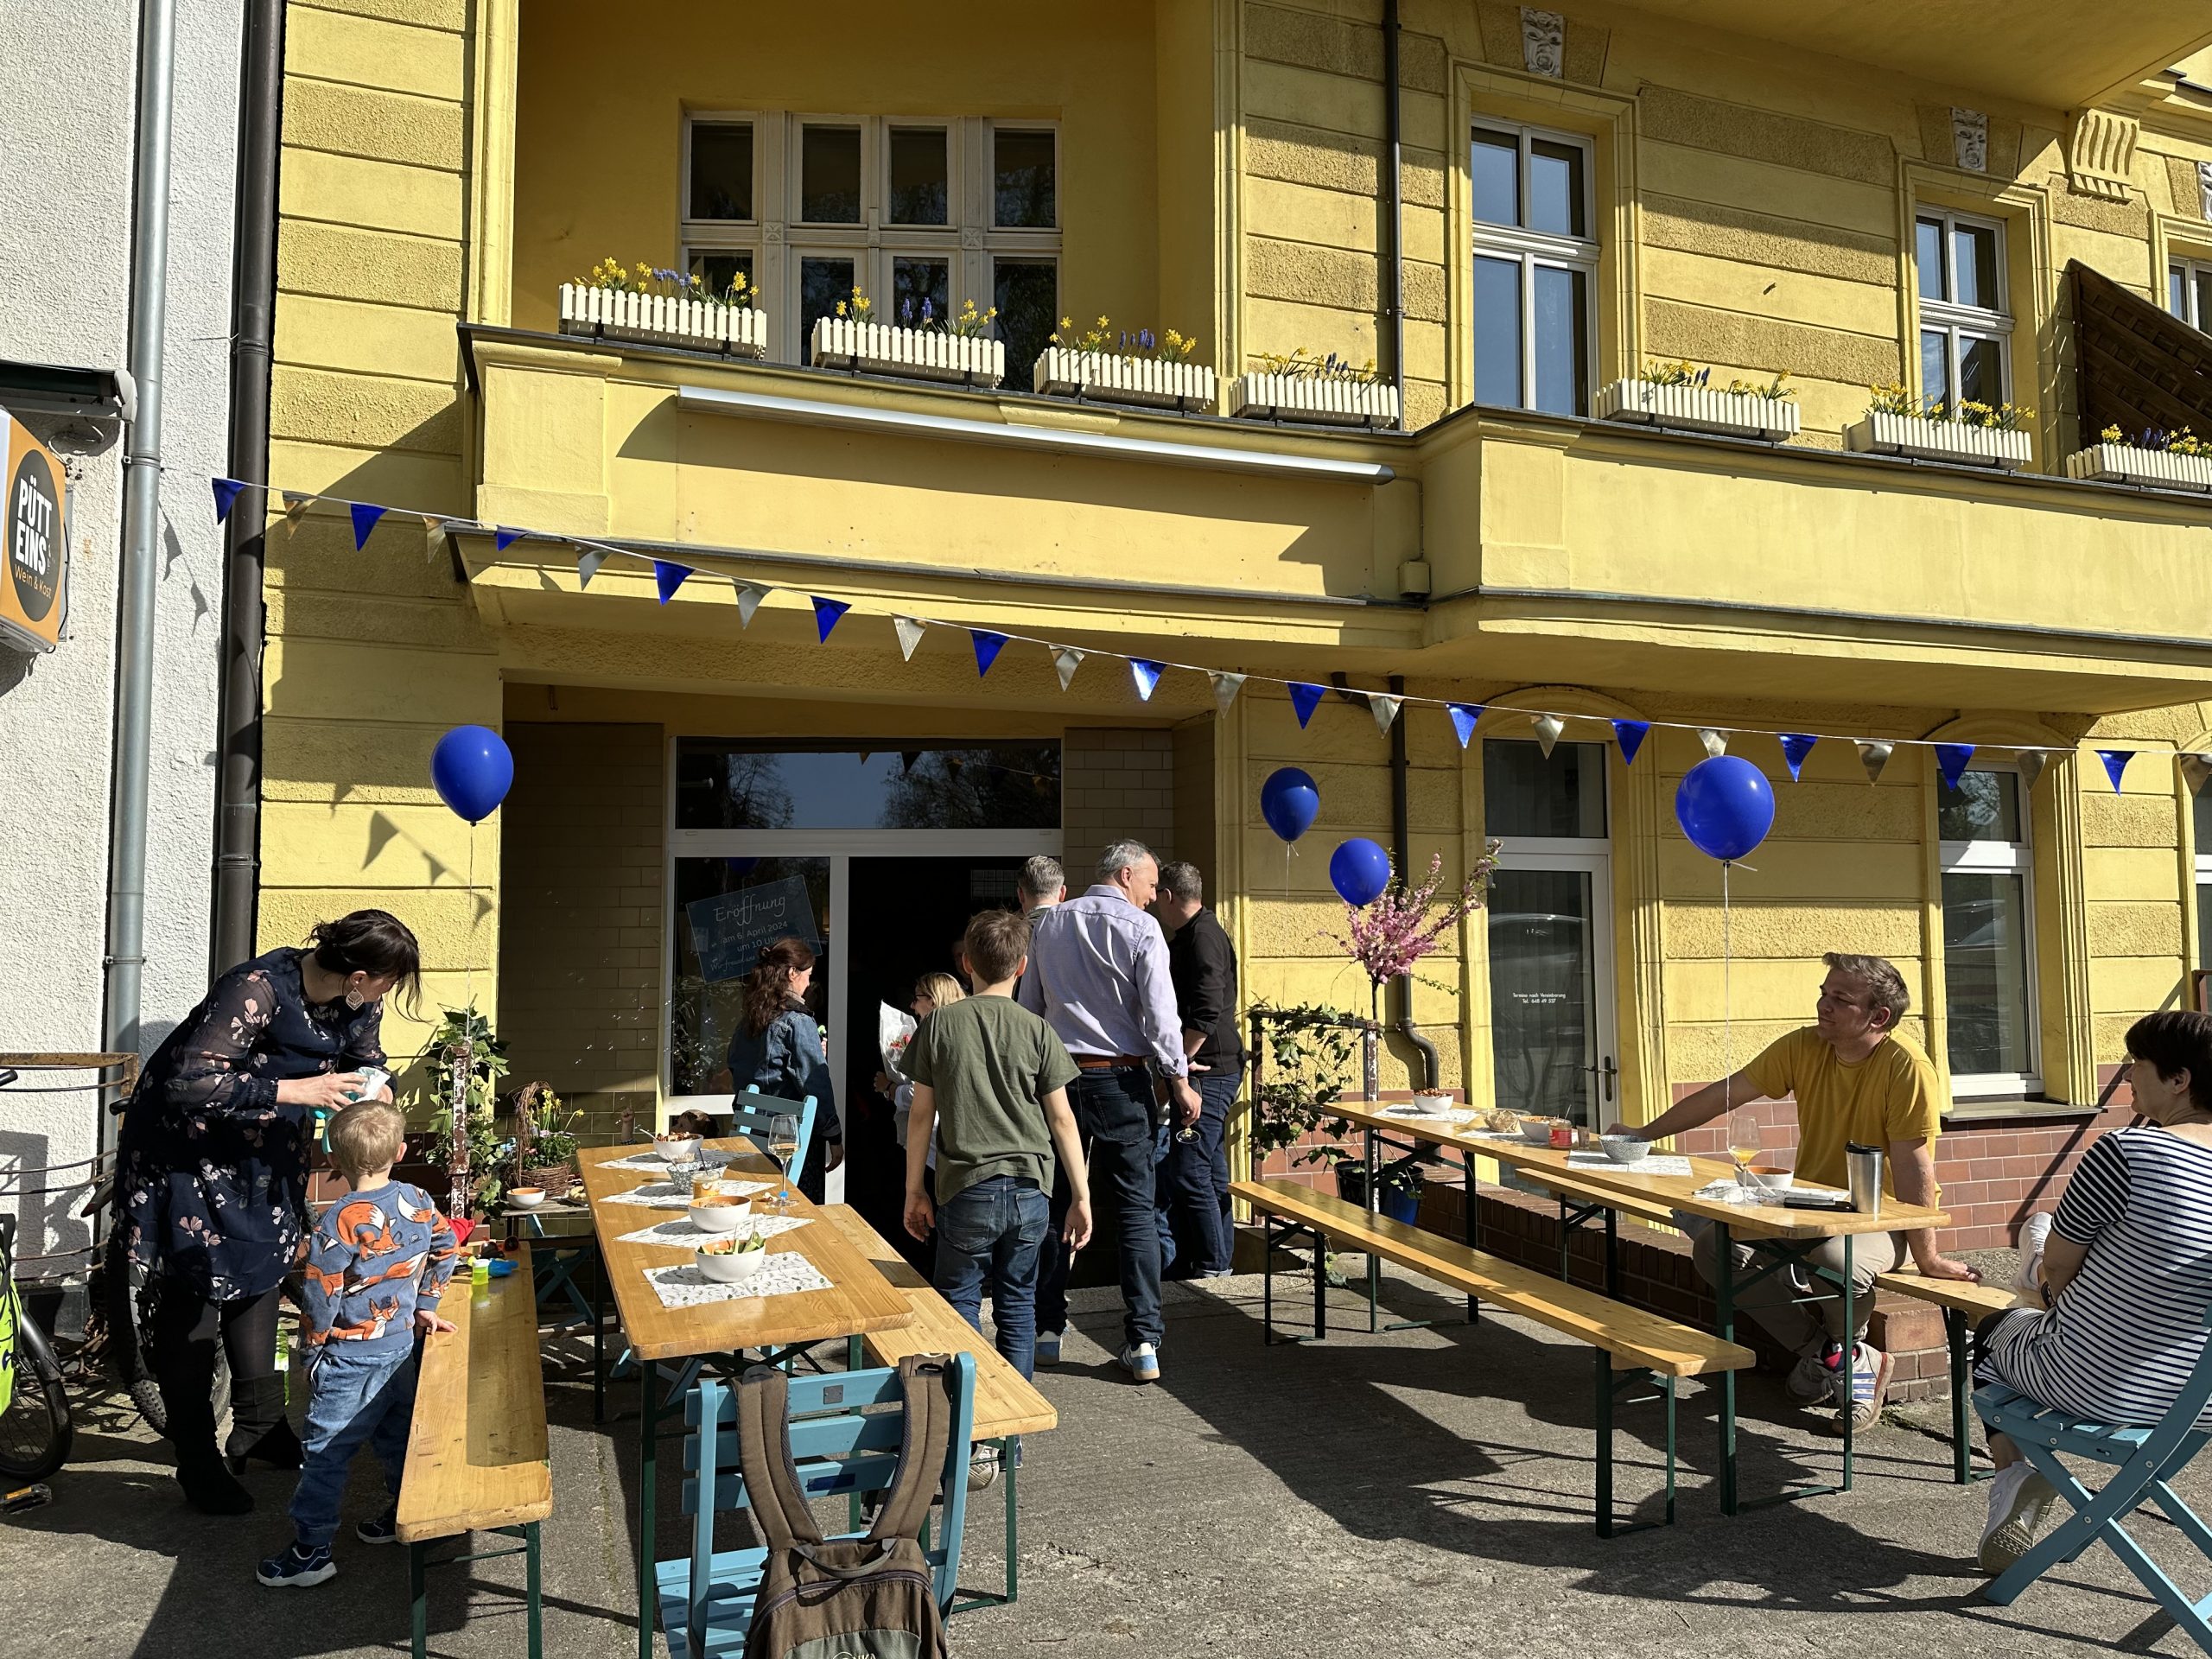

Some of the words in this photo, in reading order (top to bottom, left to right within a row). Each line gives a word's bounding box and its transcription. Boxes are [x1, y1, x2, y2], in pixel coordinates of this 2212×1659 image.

[18, 474, 52, 538] PÜTT
[16, 518, 47, 575] EINS
[15, 564, 32, 587] Wein
[34, 576, 39, 591] &
[39, 580, 52, 600] Kost
[713, 893, 785, 926] Eröffnung
[723, 935, 736, 944] am
[747, 926, 766, 938] April
[768, 920, 788, 932] 2024
[737, 943, 750, 953] um
[752, 939, 762, 949] 10
